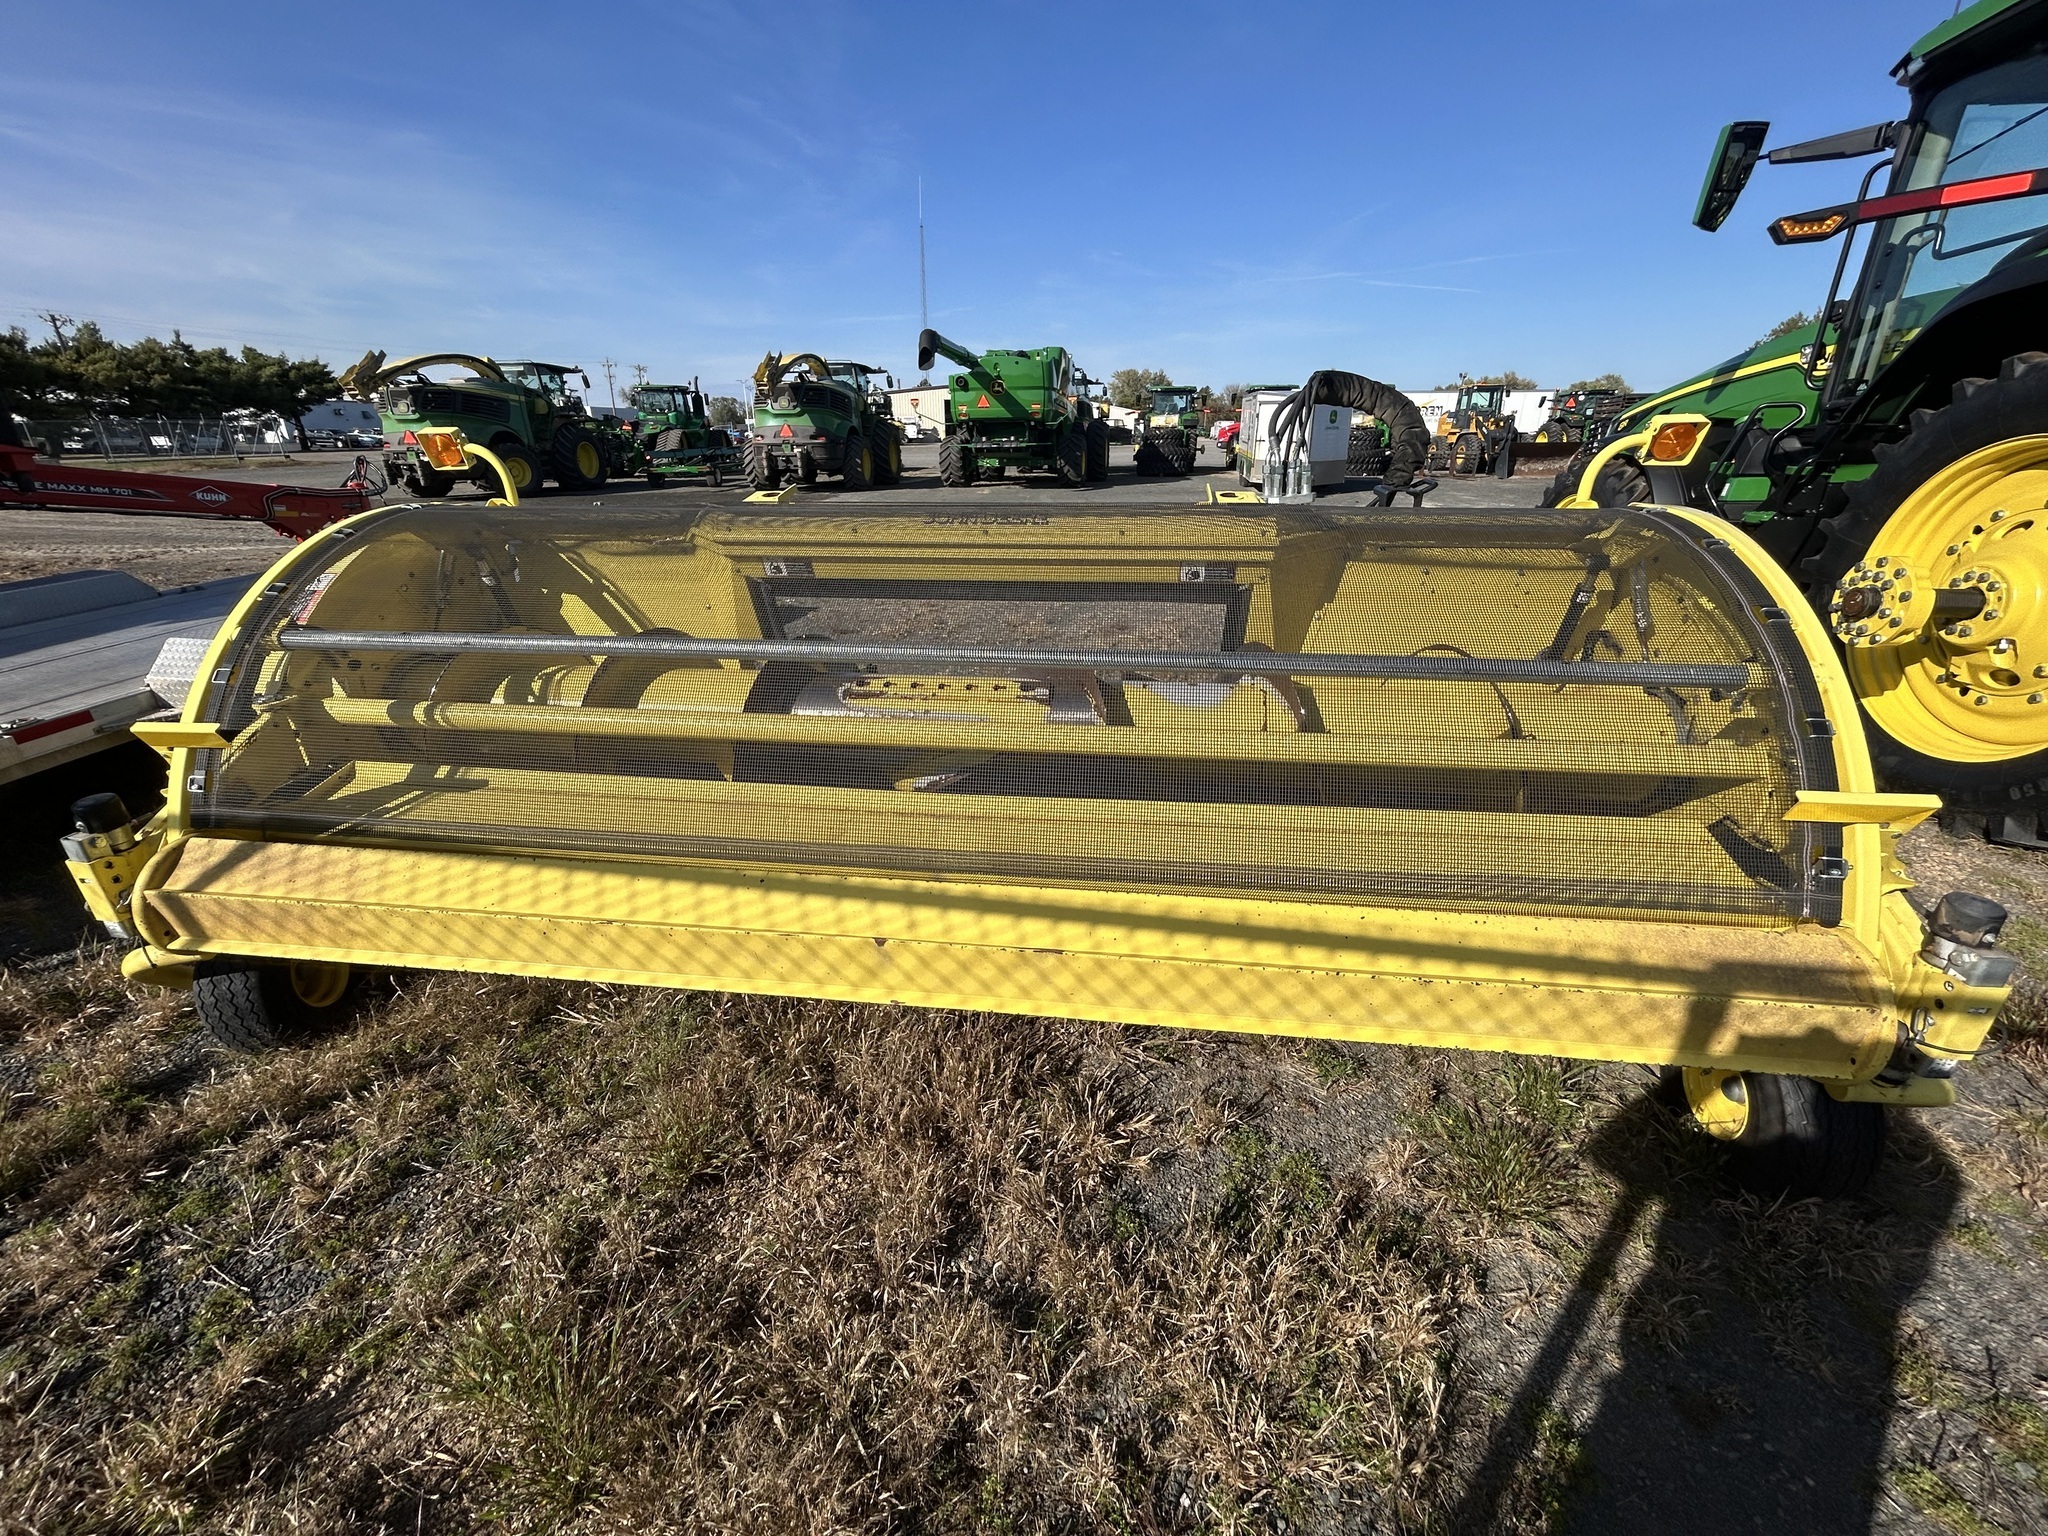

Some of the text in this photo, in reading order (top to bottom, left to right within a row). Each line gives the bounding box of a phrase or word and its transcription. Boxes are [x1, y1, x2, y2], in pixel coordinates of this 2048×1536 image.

[47, 482, 87, 492] MAXX
[90, 486, 110, 494] MM
[196, 492, 227, 501] KUHN
